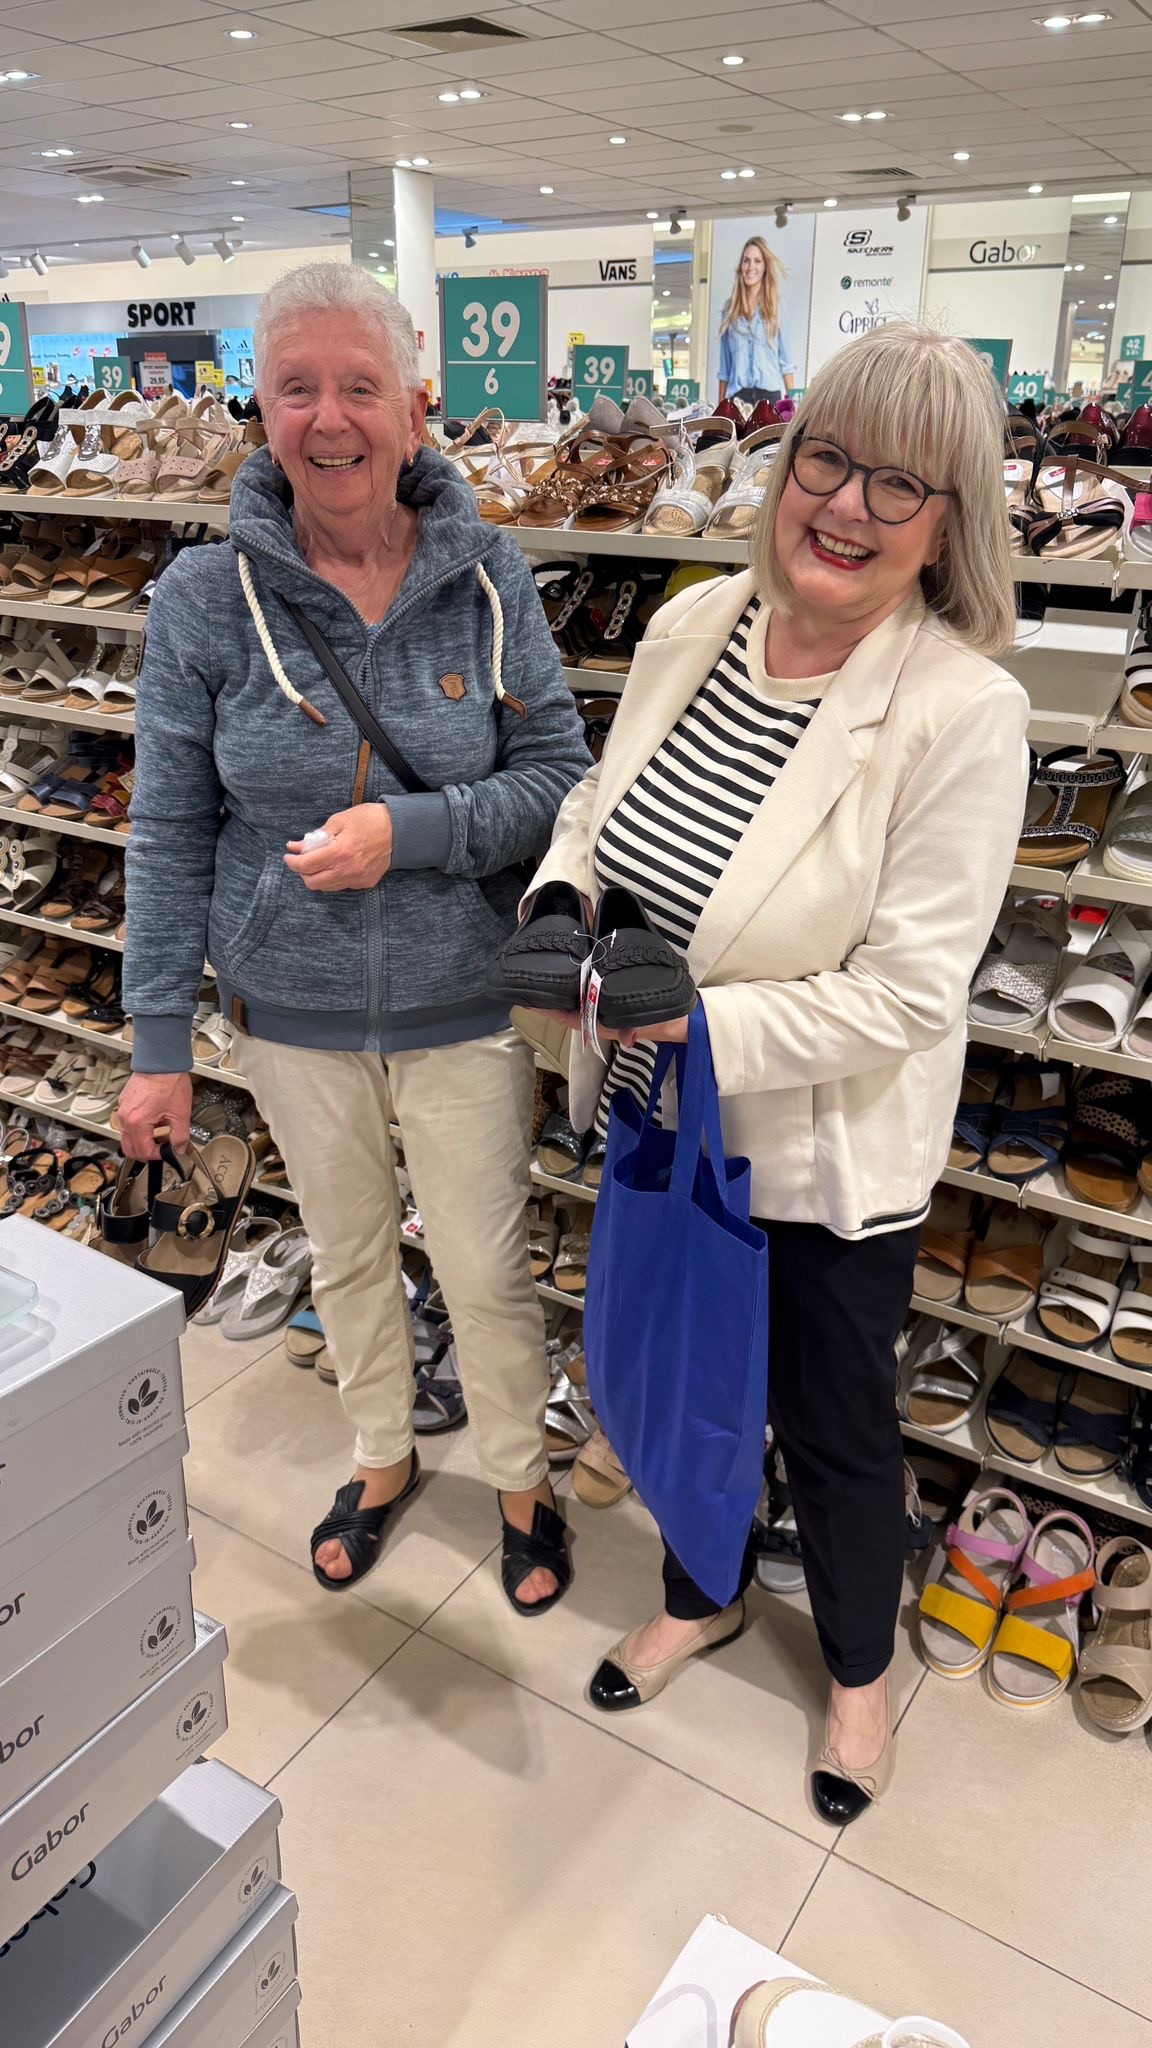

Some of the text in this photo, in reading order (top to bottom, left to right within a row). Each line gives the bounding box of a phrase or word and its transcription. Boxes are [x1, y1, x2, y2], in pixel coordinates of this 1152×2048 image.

[969, 239, 1042, 265] Gabor
[599, 258, 637, 281] VANS
[853, 277, 892, 287] remonte
[127, 301, 197, 328] SPORT
[462, 301, 521, 358] 39
[102, 365, 123, 389] 39
[484, 367, 499, 395] 6
[583, 355, 616, 385] 39
[671, 384, 690, 398] 40
[1013, 381, 1037, 398] 40
[214, 1154, 233, 1183] ACO
[11, 1802, 90, 1881] Gabor
[102, 1974, 167, 2048] Gabor
